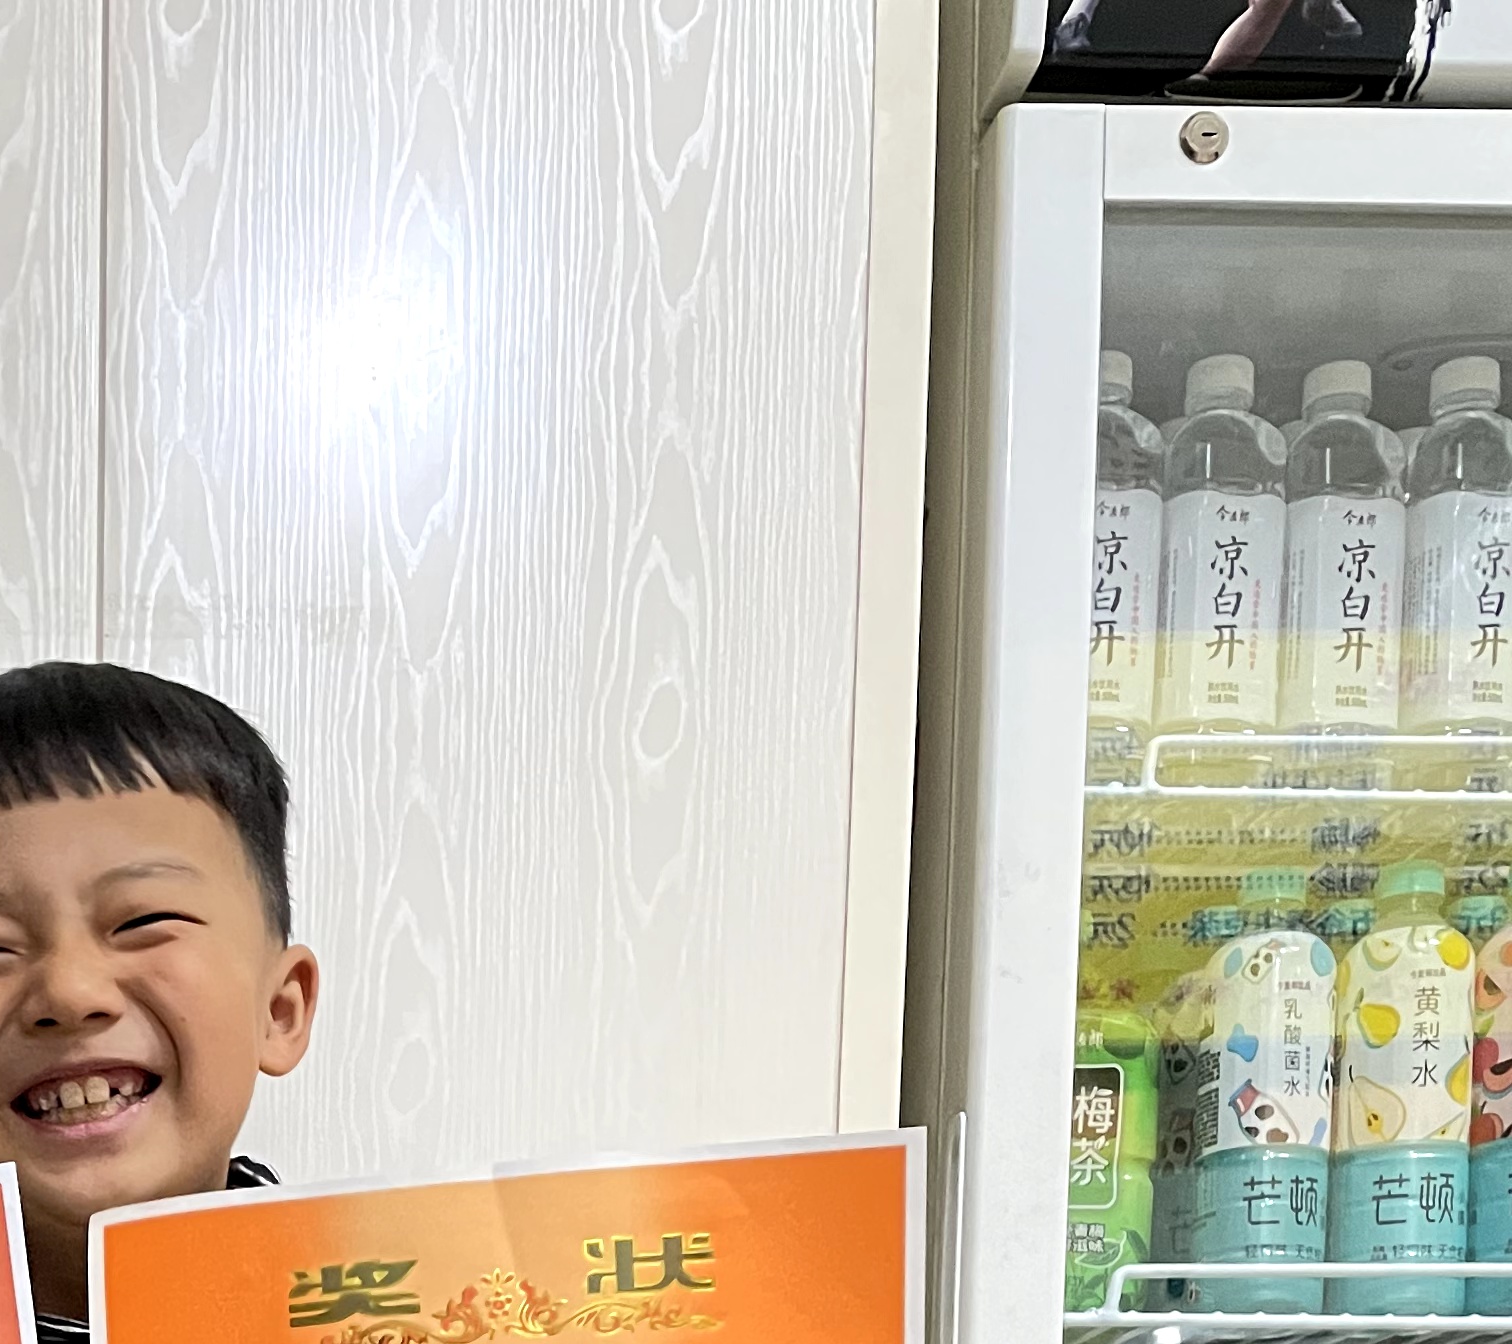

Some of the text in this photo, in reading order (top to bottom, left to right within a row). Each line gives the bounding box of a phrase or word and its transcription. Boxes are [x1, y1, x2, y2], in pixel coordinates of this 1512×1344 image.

[1205, 535, 1249, 669] 凉白开
[1333, 538, 1376, 673] 凉白开
[1470, 536, 1511, 668] 凉白开
[1283, 998, 1303, 1098] 乳酸菌水
[1411, 985, 1442, 1088] 黄梨水
[1242, 1174, 1319, 1227] 芒顿
[1371, 1171, 1456, 1226] 芒顿
[287, 1231, 716, 1328] 奖 状
